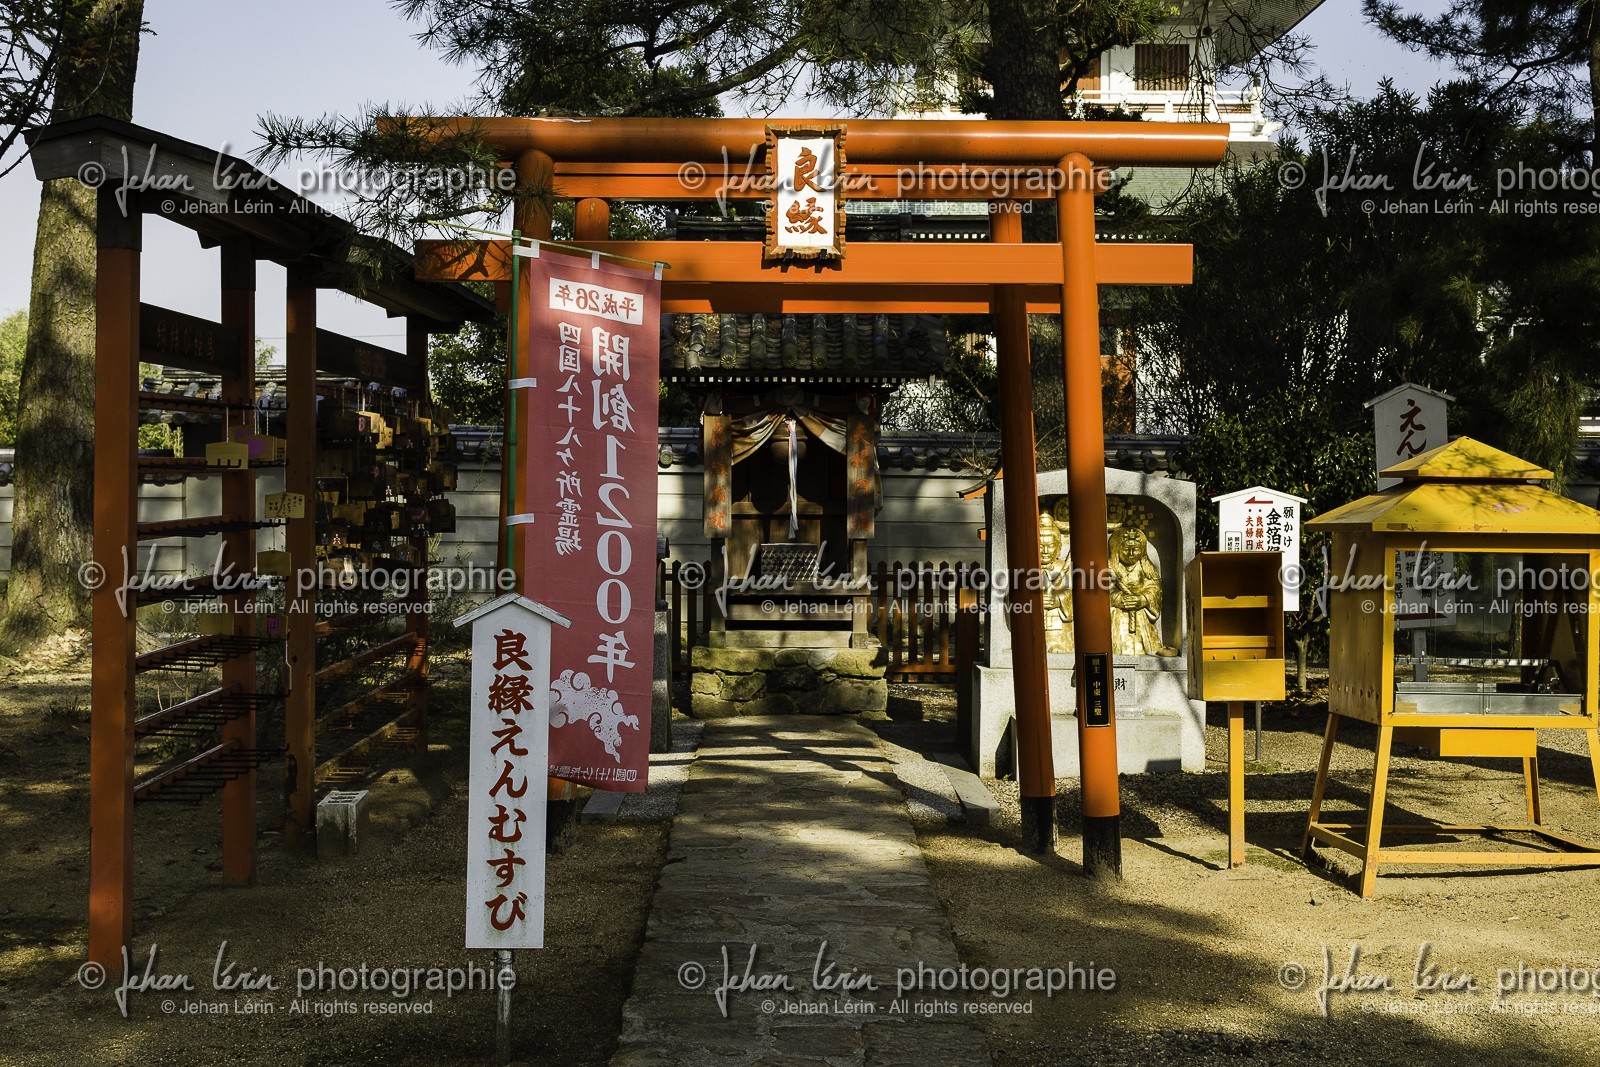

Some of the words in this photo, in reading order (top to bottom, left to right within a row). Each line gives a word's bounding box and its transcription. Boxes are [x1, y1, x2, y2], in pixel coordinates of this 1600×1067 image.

[784, 146, 828, 234] 良縁
[1396, 398, 1427, 460] えん
[1282, 506, 1294, 548] 願かけ
[484, 628, 535, 932] 良縁えんむすび
